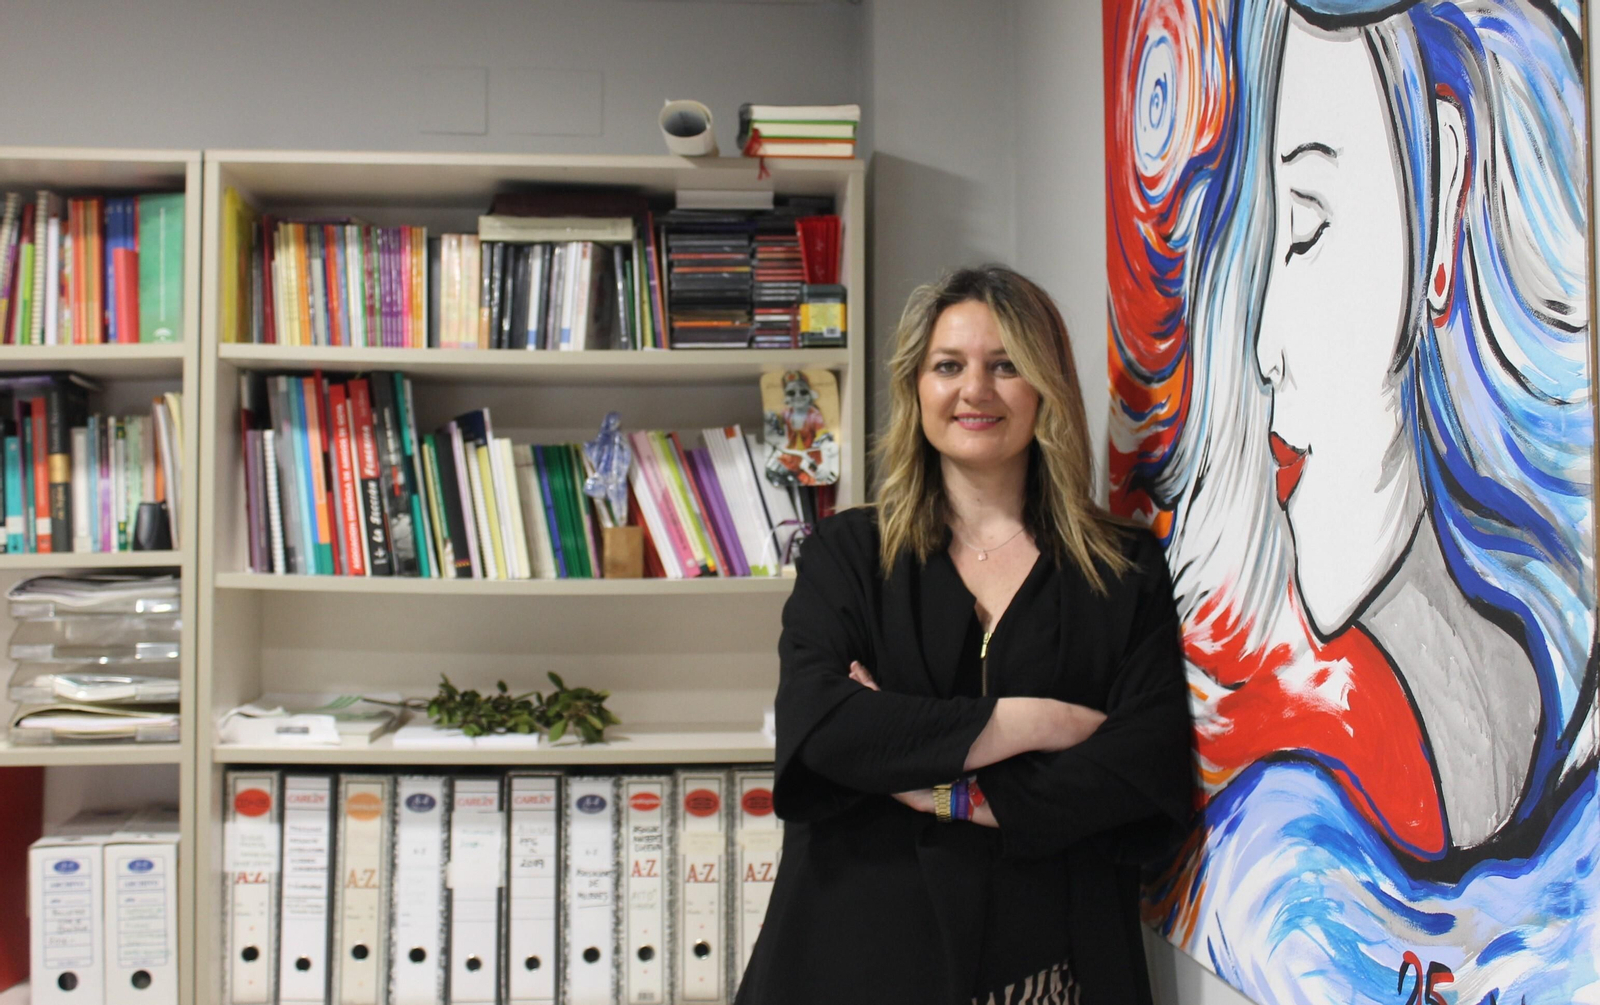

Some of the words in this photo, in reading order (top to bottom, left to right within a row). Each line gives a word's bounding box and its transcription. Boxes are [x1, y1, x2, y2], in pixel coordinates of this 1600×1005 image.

[345, 867, 379, 889] A-Z
[631, 859, 659, 878] A-Z
[685, 863, 717, 883] A-Z
[743, 862, 775, 883] A-Z
